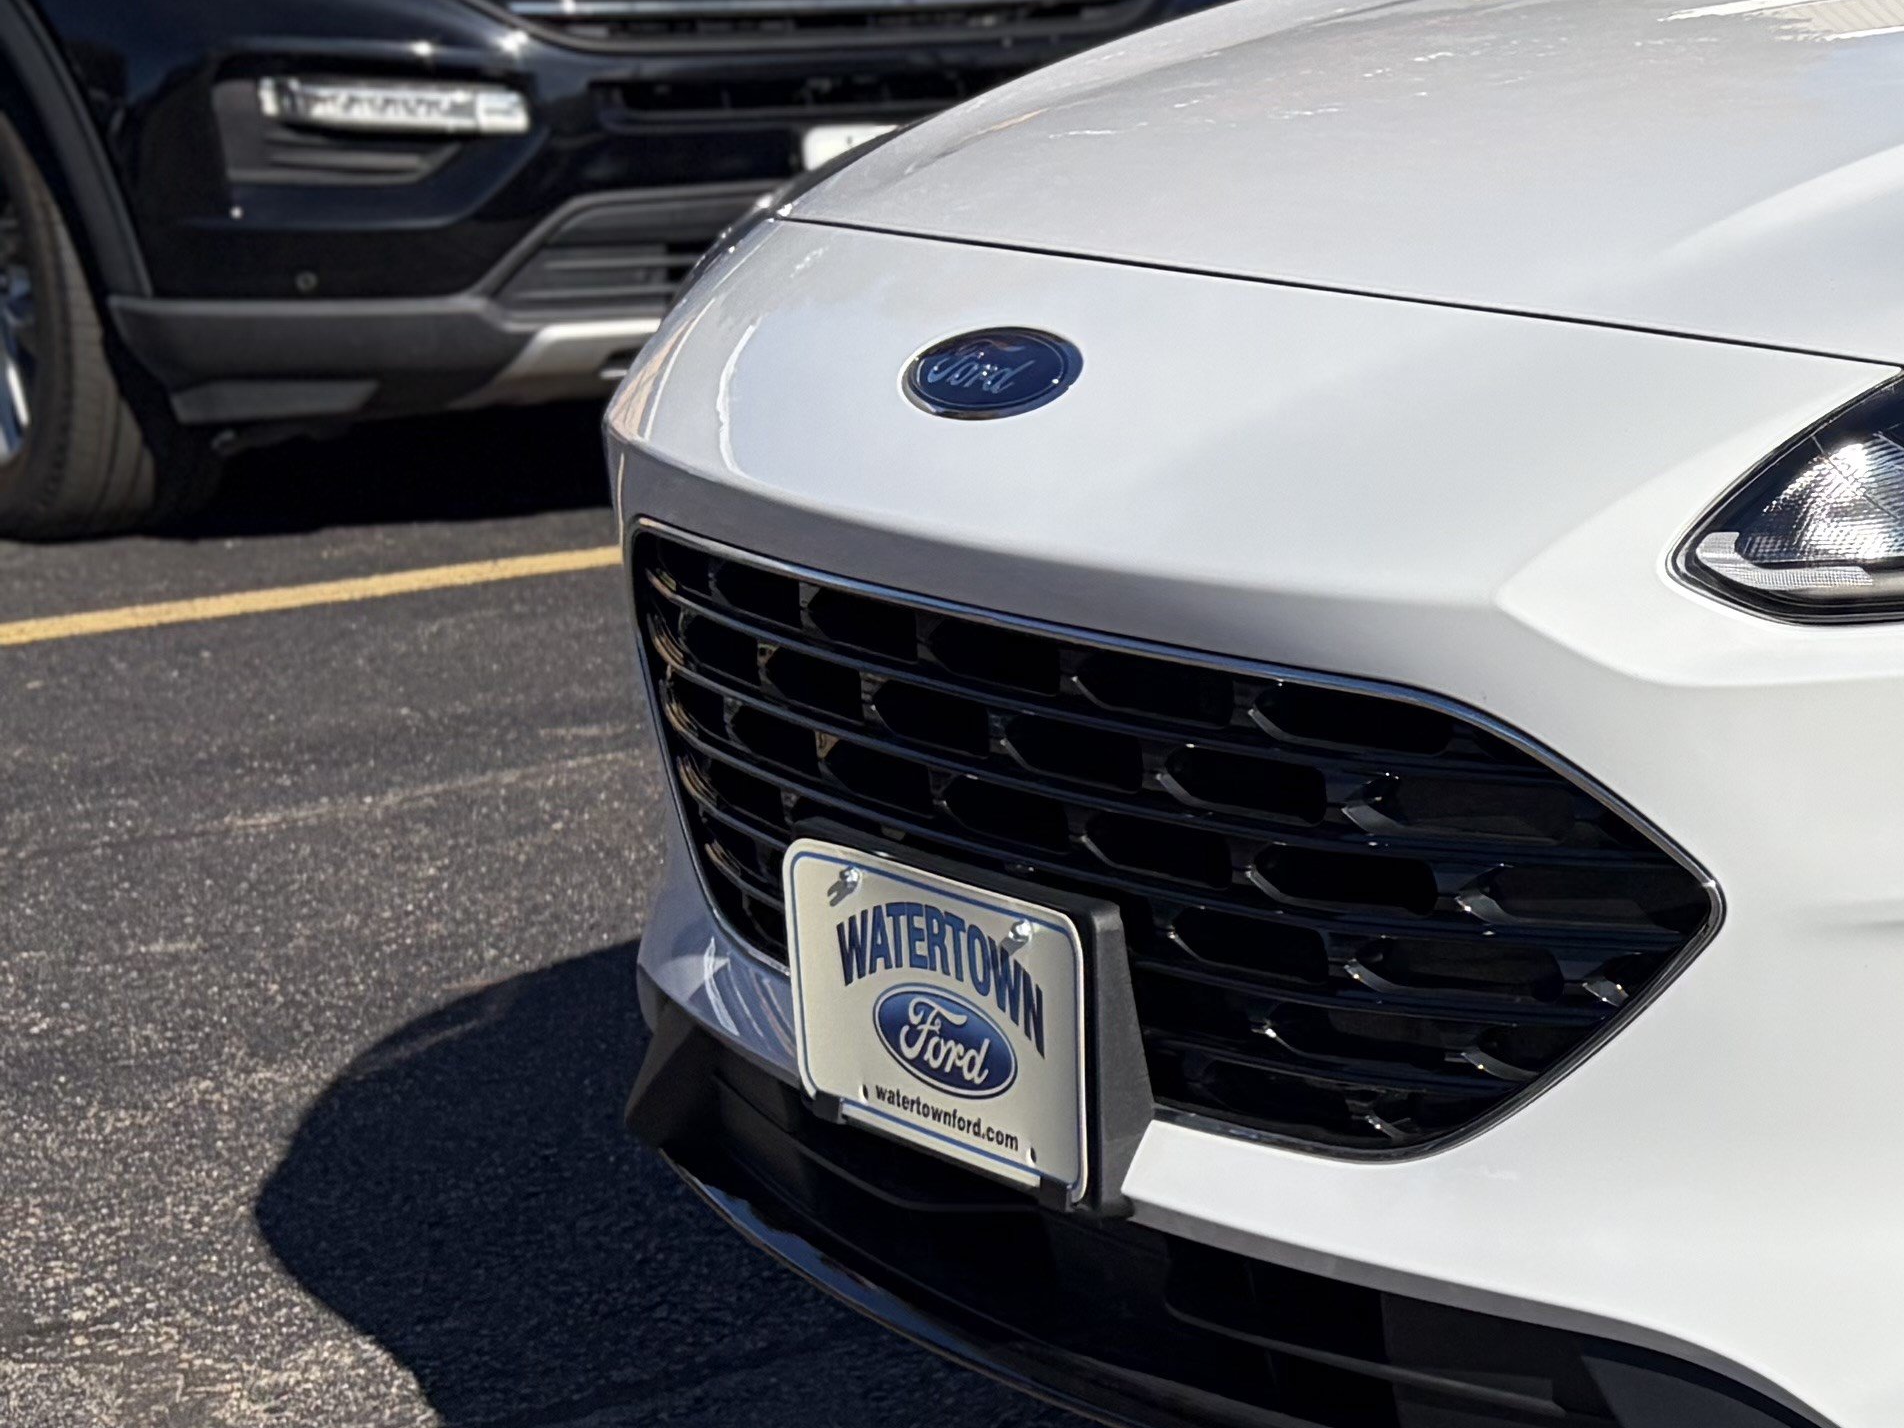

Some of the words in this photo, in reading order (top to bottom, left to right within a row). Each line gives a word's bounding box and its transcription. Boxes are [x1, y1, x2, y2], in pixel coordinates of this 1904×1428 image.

[927, 338, 1036, 394] Ford
[836, 901, 1045, 1059] WATERTOWN
[899, 996, 991, 1085] Ford
[875, 1083, 1020, 1152] watertownford.com
